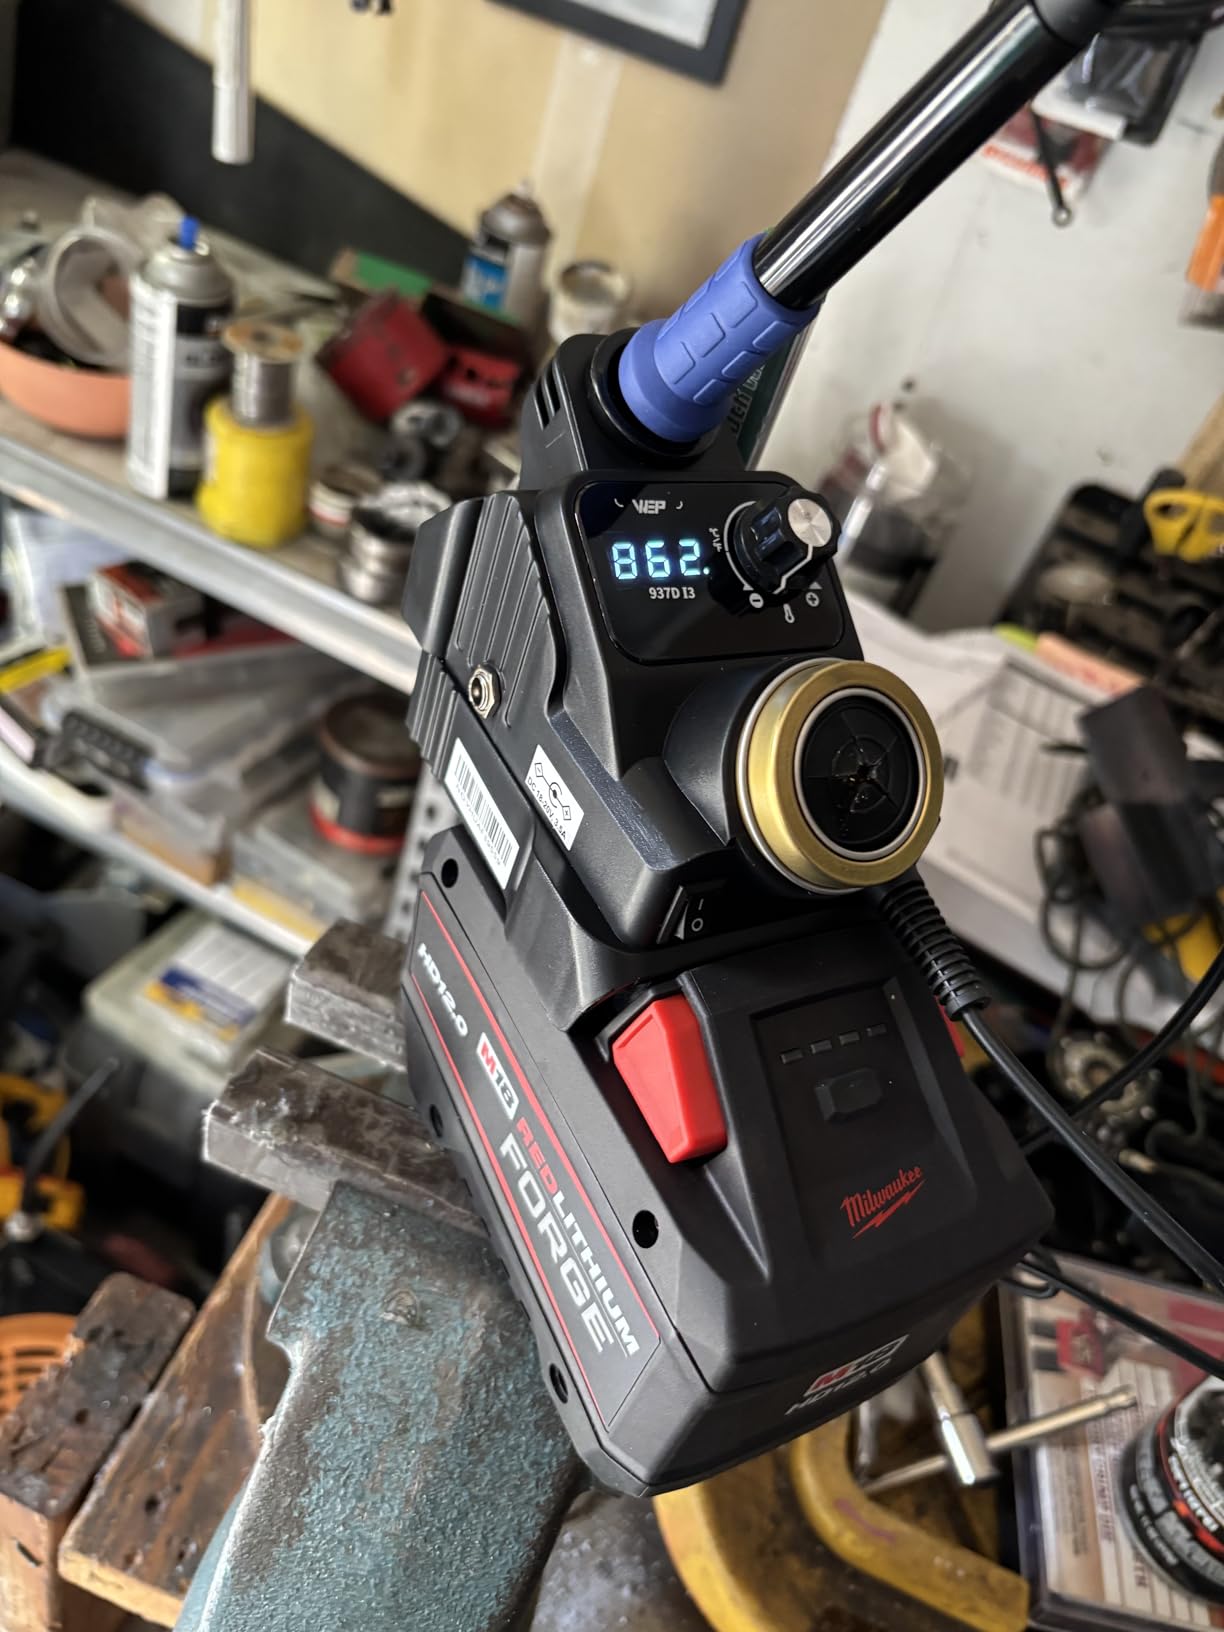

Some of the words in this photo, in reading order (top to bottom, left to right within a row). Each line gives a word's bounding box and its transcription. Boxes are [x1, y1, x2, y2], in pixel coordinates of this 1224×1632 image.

[649, 586, 681, 600] 937D
[526, 776, 537, 792] DC
[416, 942, 468, 1037] HD12.0
[478, 1037, 517, 1111] M18
[840, 1165, 923, 1228] Milwaukee
[500, 1132, 615, 1353] FORGE
